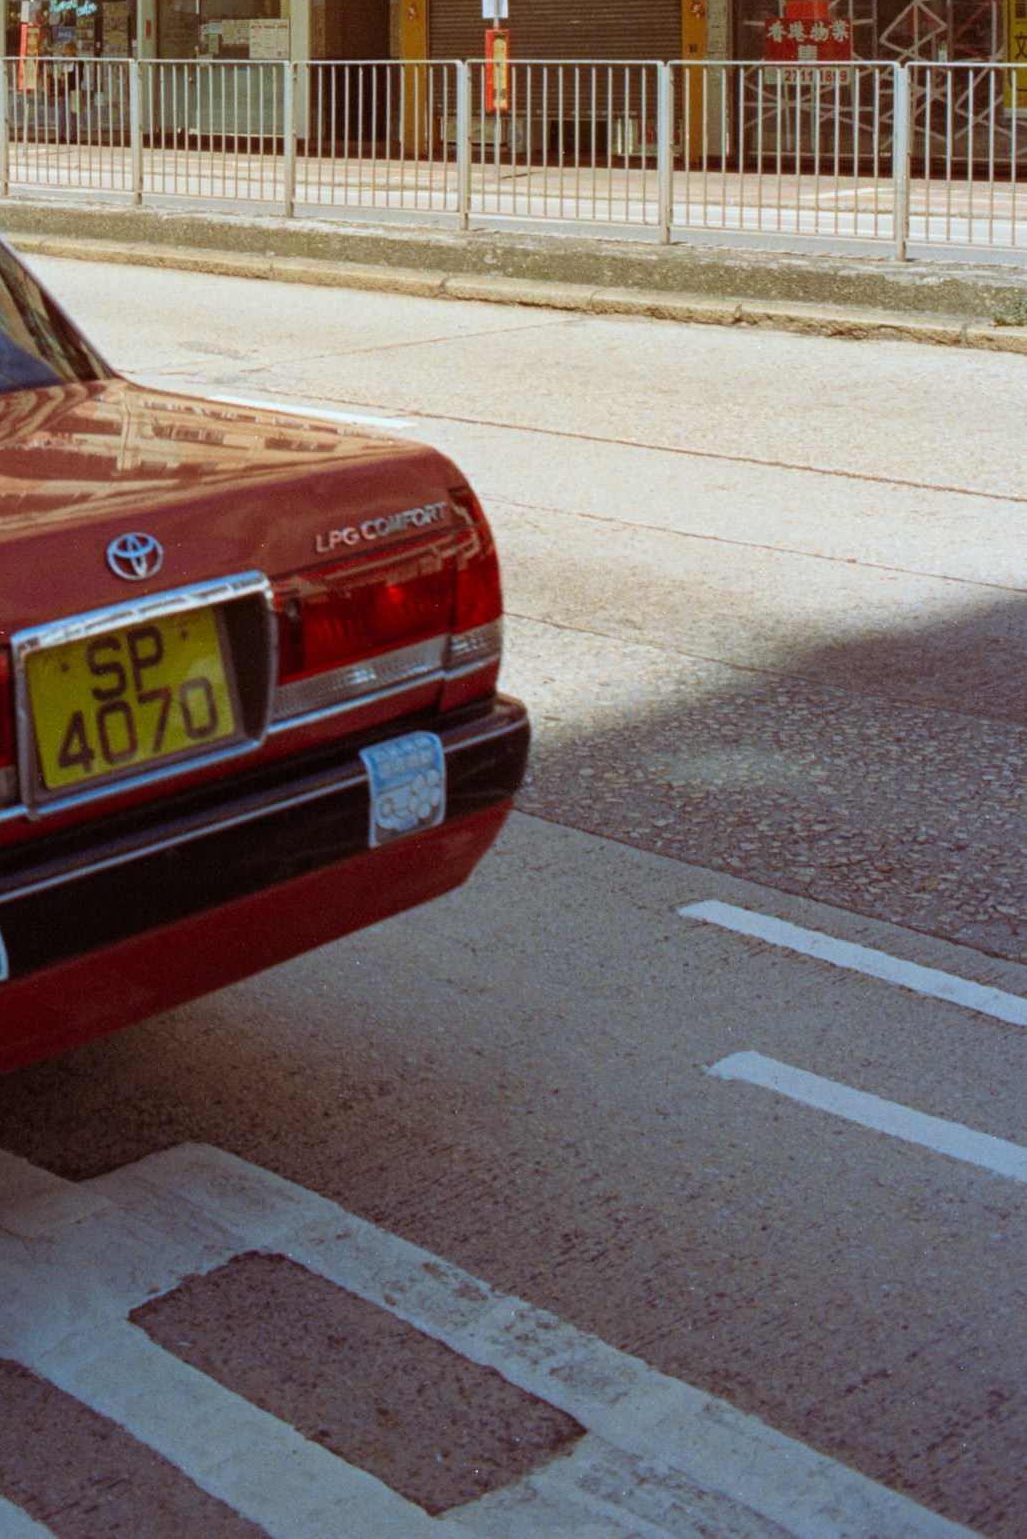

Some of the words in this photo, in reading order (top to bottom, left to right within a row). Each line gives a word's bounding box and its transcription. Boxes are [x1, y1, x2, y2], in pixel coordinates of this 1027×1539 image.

[315, 526, 361, 553] LPG
[361, 501, 447, 540] COMFORT
[85, 625, 164, 701] SP
[59, 675, 218, 773] 4070
